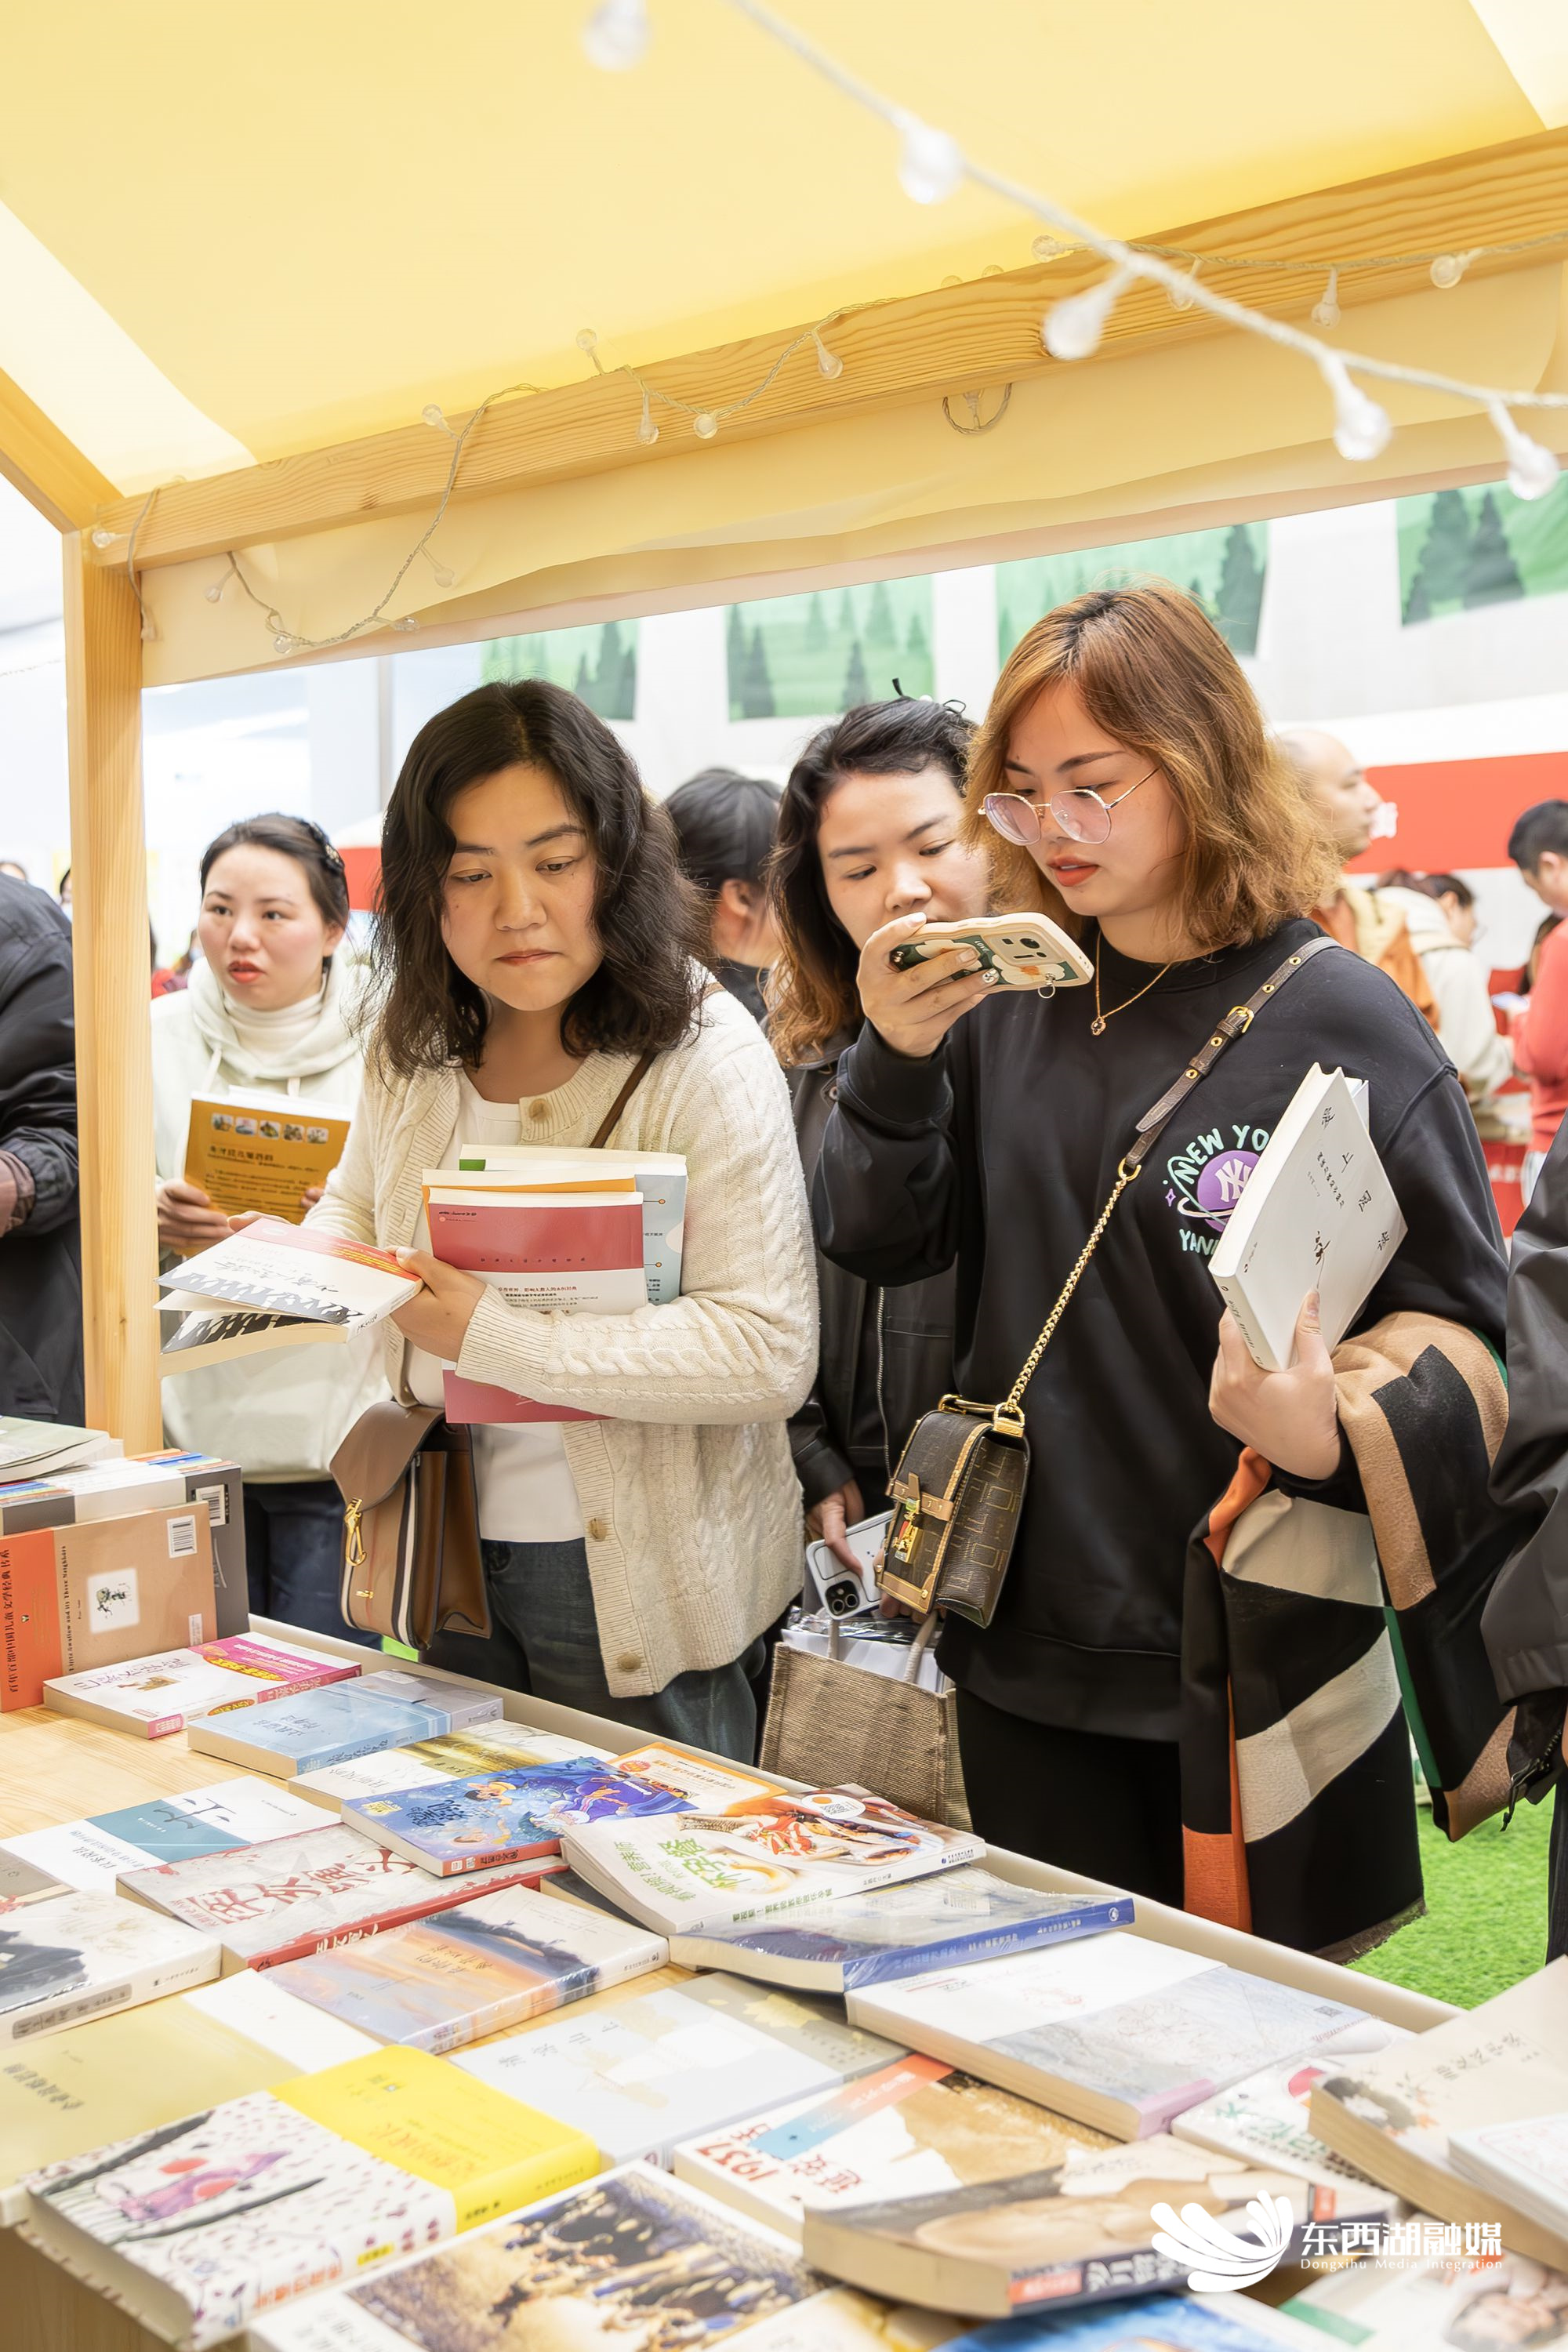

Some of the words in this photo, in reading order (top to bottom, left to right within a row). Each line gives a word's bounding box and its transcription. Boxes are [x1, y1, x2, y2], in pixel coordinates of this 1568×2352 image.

[1174, 1127, 1225, 1185] NEW
[1232, 1124, 1270, 1152] YO
[1178, 1229, 1219, 1256] YAN
[192, 1846, 419, 1926] 辛亥演义
[656, 1836, 752, 1891] 怀孕餐
[696, 2141, 779, 2183] 1937
